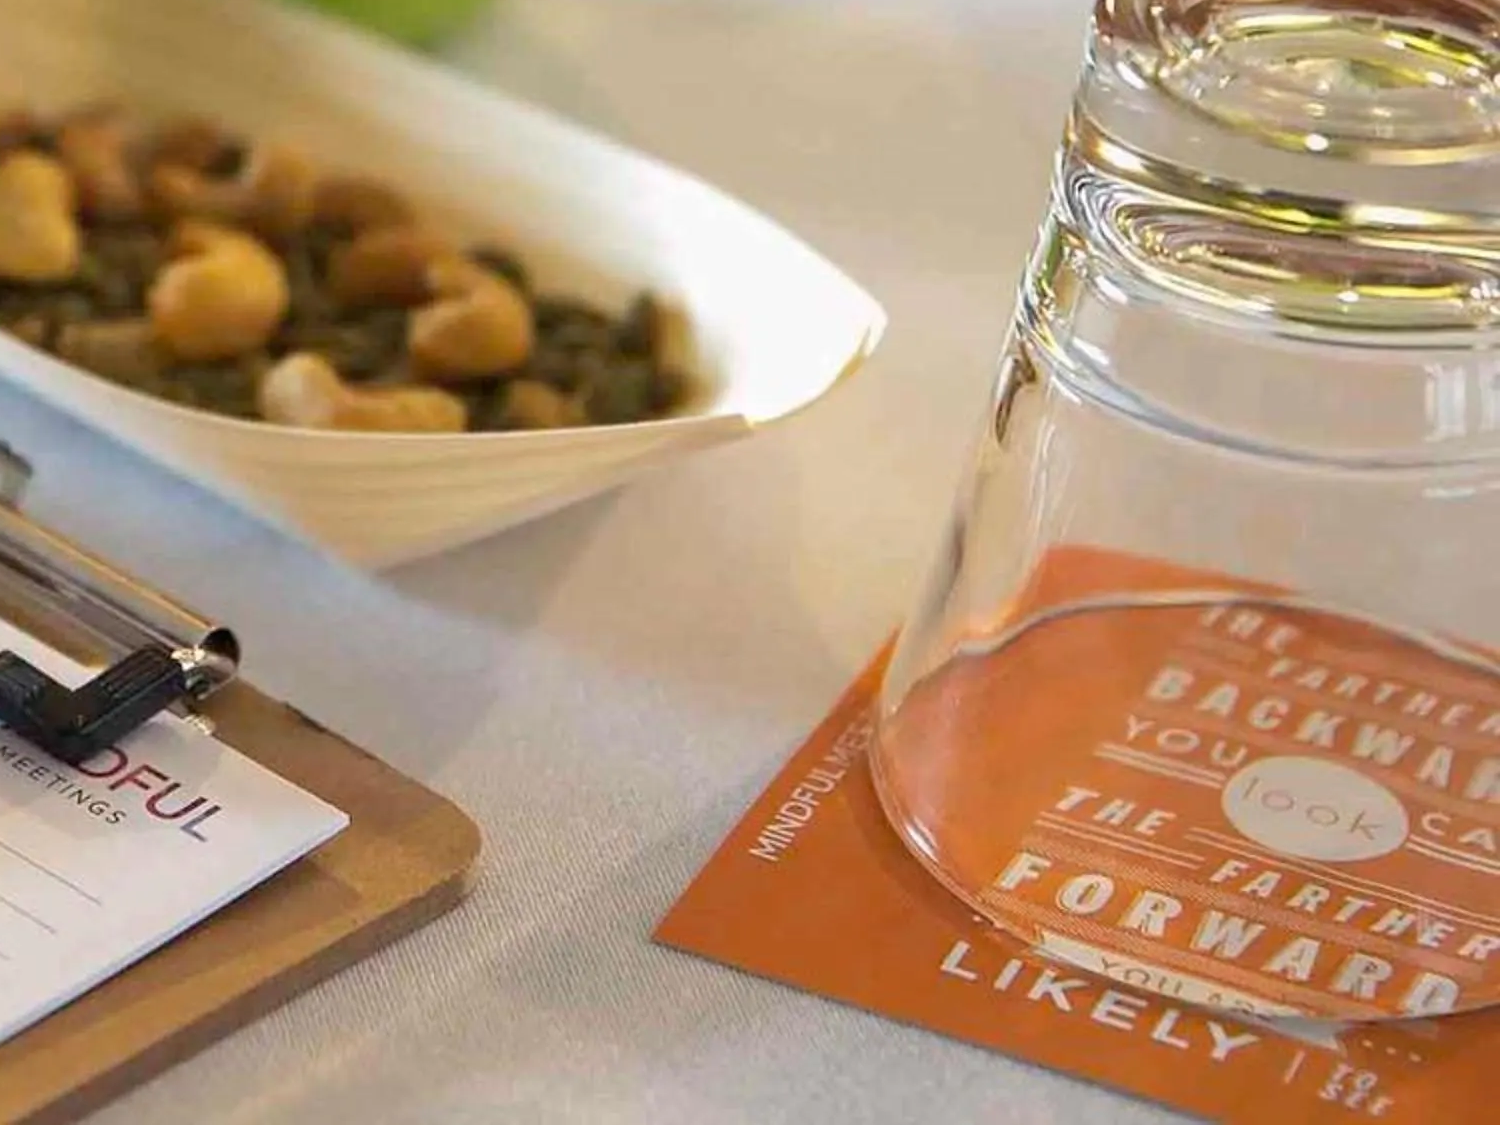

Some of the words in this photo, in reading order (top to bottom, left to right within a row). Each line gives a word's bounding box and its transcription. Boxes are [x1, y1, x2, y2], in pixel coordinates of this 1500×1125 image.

[76, 746, 222, 843] DFUL
[749, 766, 847, 863] MINDFUL
[1055, 787, 1177, 836] THE
[1125, 715, 1248, 766] YOU
[1242, 777, 1383, 841] look
[994, 852, 1460, 1015] FORWARD
[1209, 859, 1500, 960] FARTHER
[940, 940, 1261, 1062] LIKELY
